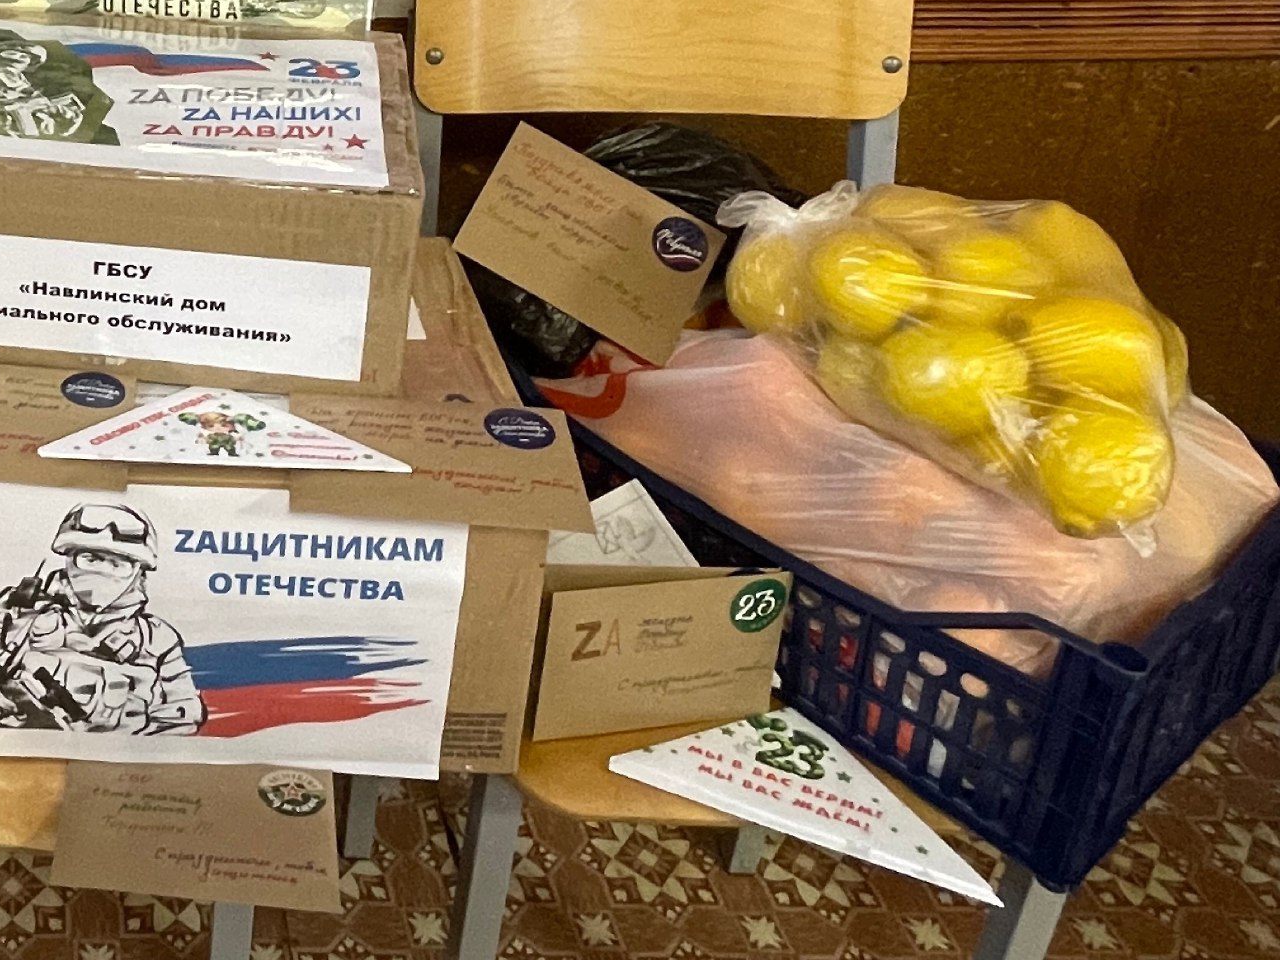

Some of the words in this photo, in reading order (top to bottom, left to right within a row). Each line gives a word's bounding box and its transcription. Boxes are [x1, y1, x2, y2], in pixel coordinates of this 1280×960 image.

[231, 106, 361, 121] НАШИХ!
[192, 124, 334, 140] ПРАВДУ!
[93, 260, 153, 280] ГБСУ
[19, 279, 174, 308] «Навлинский
[180, 296, 227, 313] дом
[107, 313, 292, 345] обслуживания»
[208, 571, 405, 601] ОТЕЧЕСТВА
[734, 588, 777, 622] 23
[687, 743, 724, 765] МЫ
[731, 757, 744, 771] В
[752, 762, 791, 788] ВАС
[697, 763, 732, 782] МЫ
[742, 777, 782, 802] ВАС
